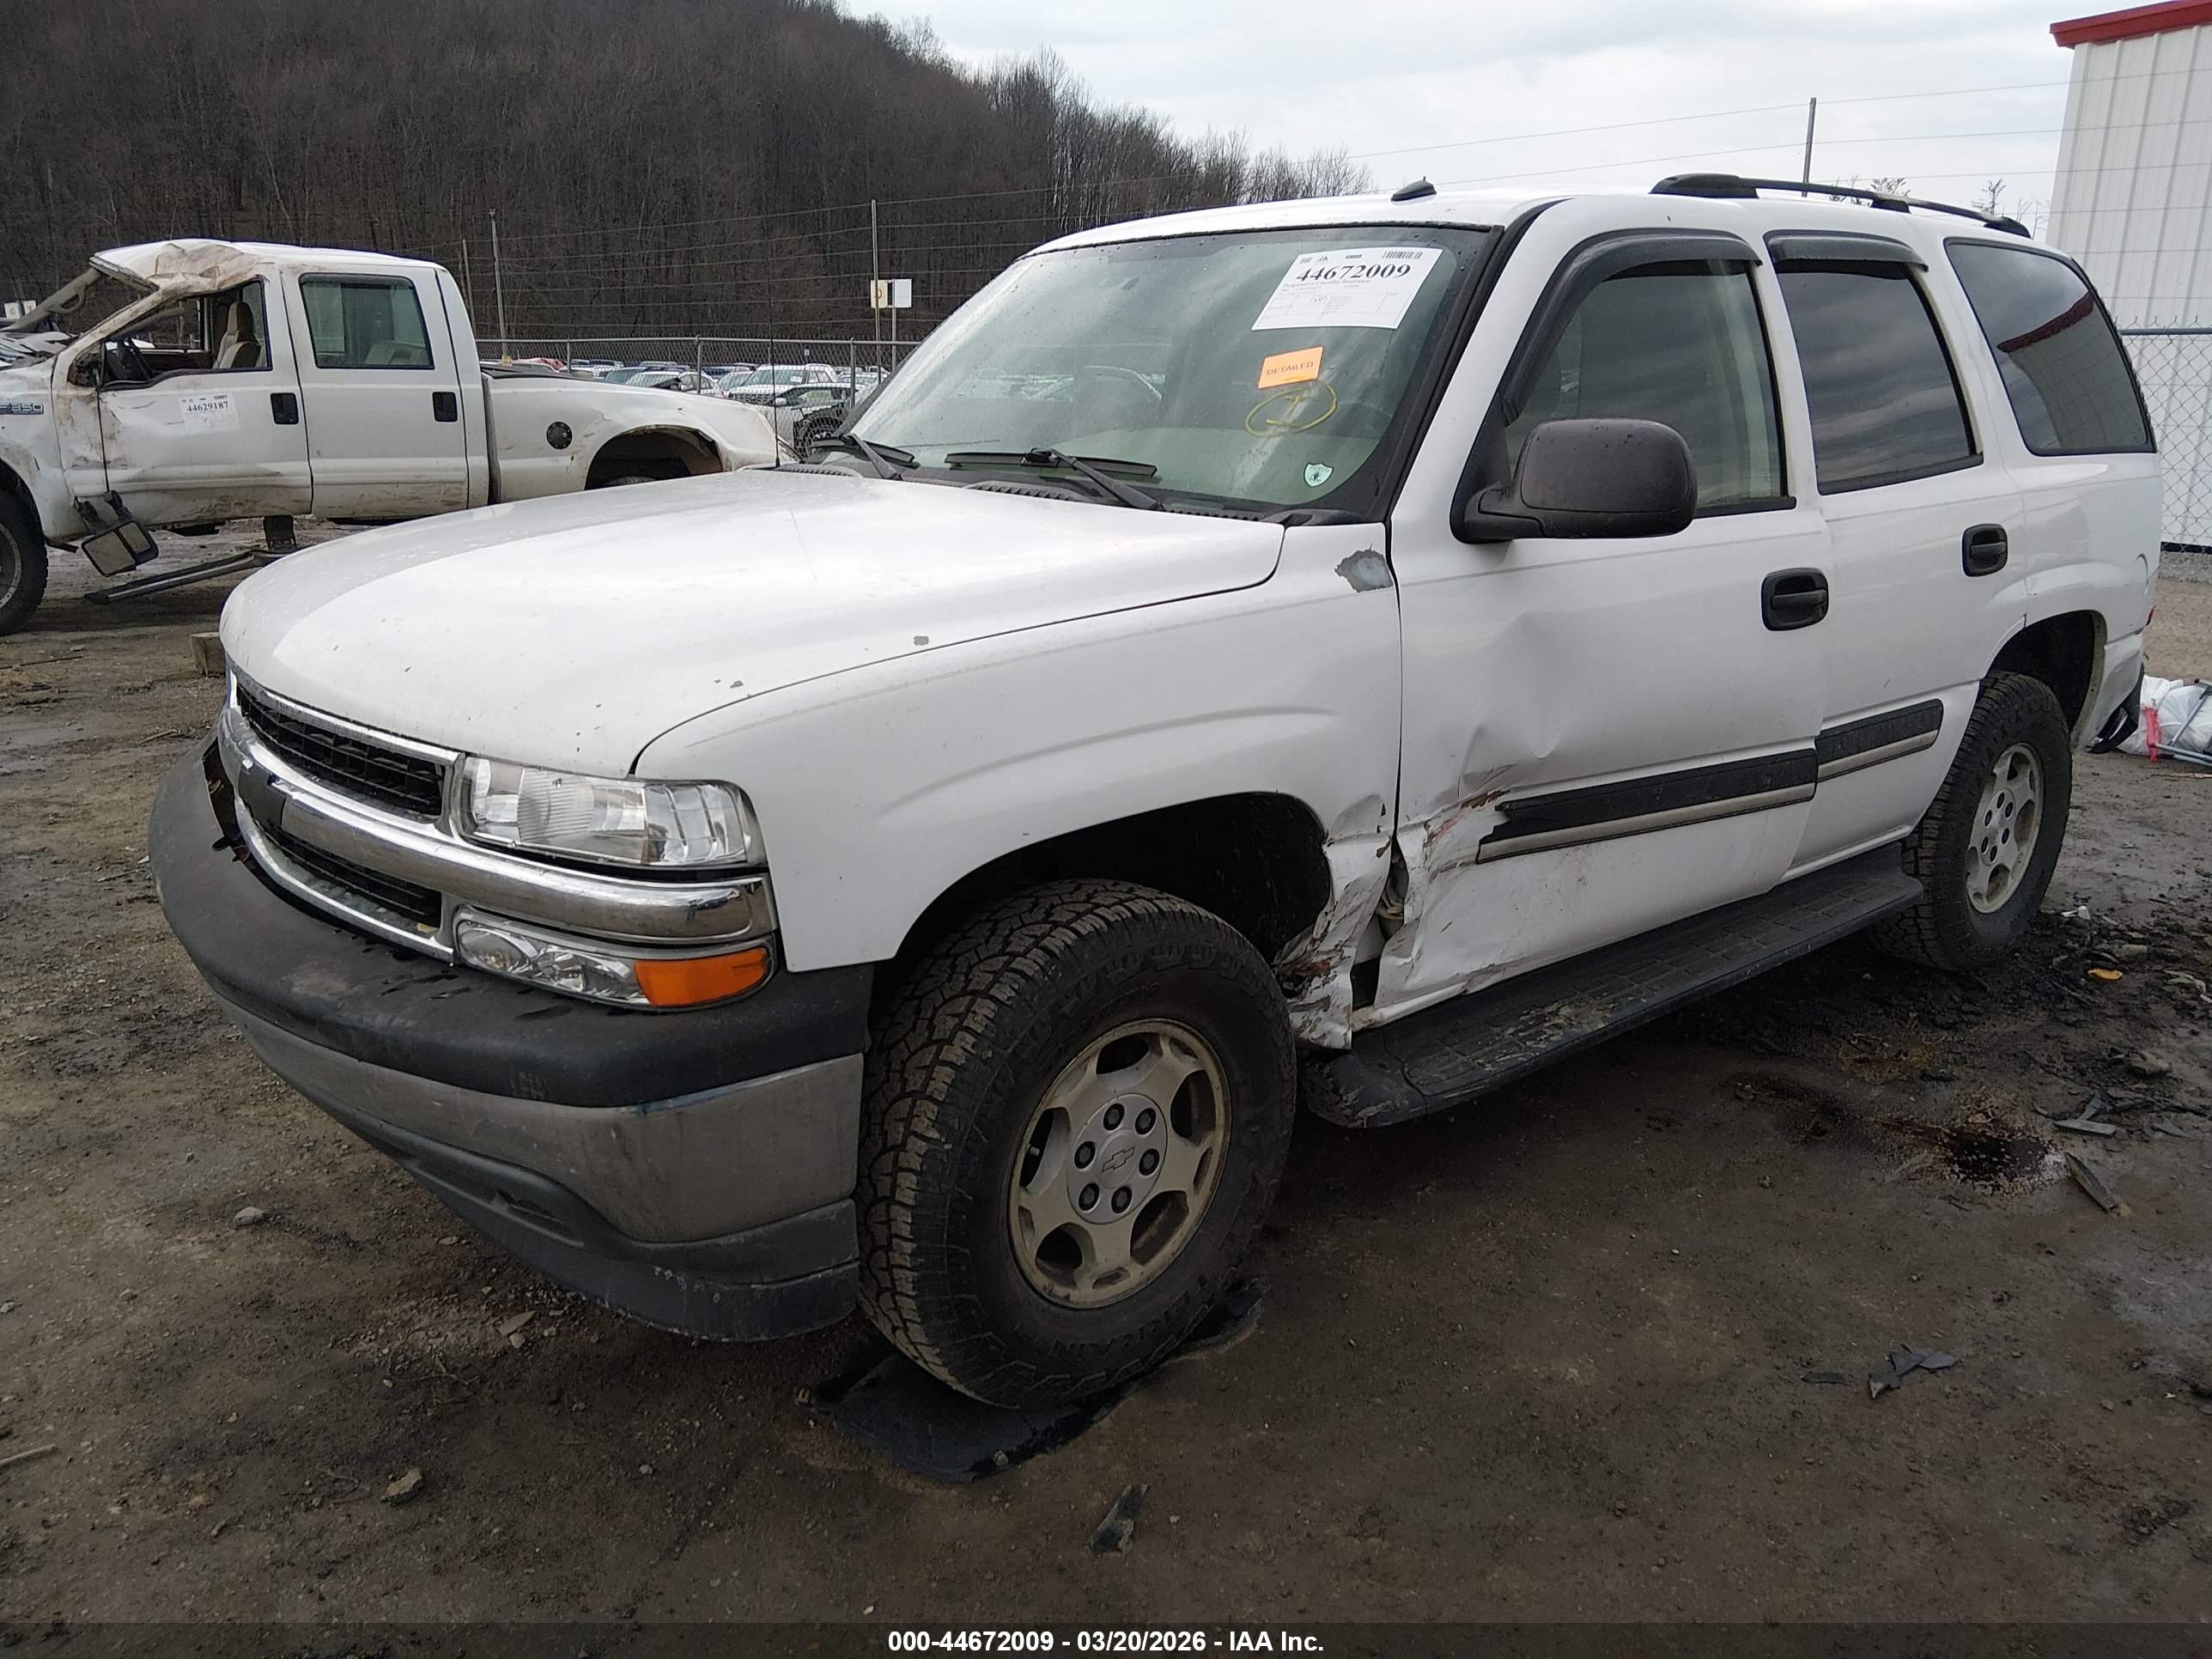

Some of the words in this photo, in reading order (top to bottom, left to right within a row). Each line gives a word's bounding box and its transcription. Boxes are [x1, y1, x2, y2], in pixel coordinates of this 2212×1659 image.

[1297, 264, 1411, 282] 44672009
[1267, 362, 1314, 375] DETAILED
[187, 401, 228, 412] 44629187
